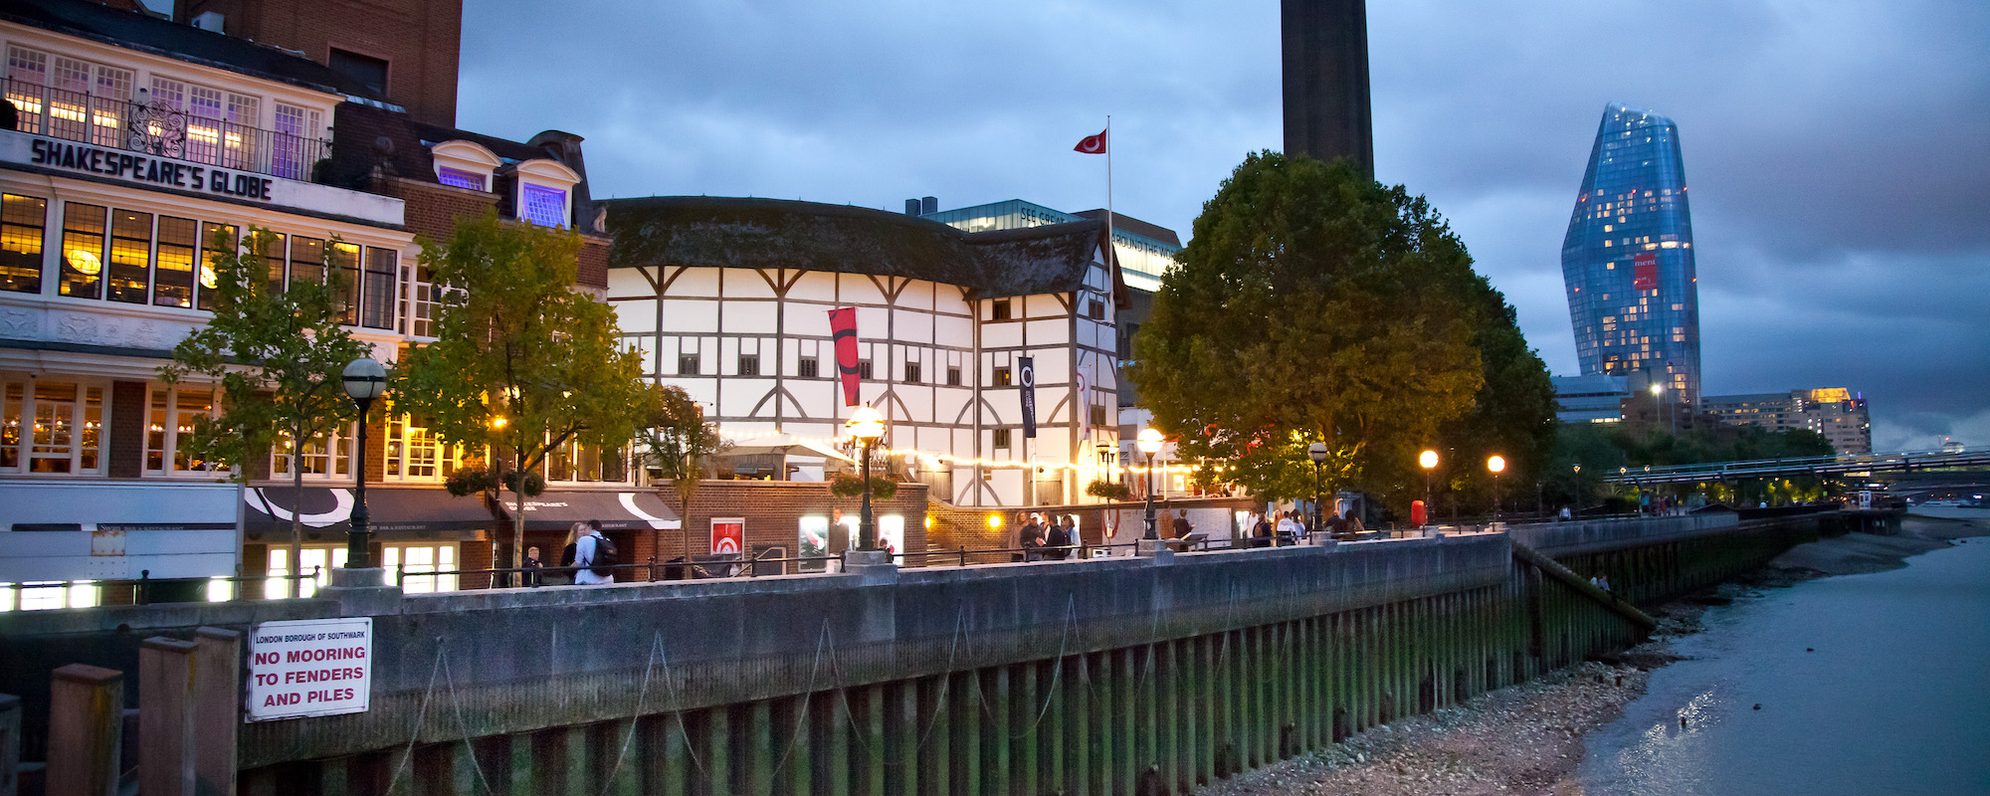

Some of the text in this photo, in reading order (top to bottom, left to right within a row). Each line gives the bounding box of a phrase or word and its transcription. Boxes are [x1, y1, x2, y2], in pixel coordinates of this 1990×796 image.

[31, 138, 273, 201] SHAKESPEARE'S GLOBE
[1021, 207, 1036, 223] SEE
[1143, 242, 1158, 257] THE
[256, 636, 283, 644] LONDON
[285, 633, 316, 643] BOROUGH
[327, 631, 365, 640] SOUTHWARK
[255, 646, 365, 665] NO MOORING
[255, 667, 364, 686] TO FENDERS
[264, 687, 354, 707] AND PILES
